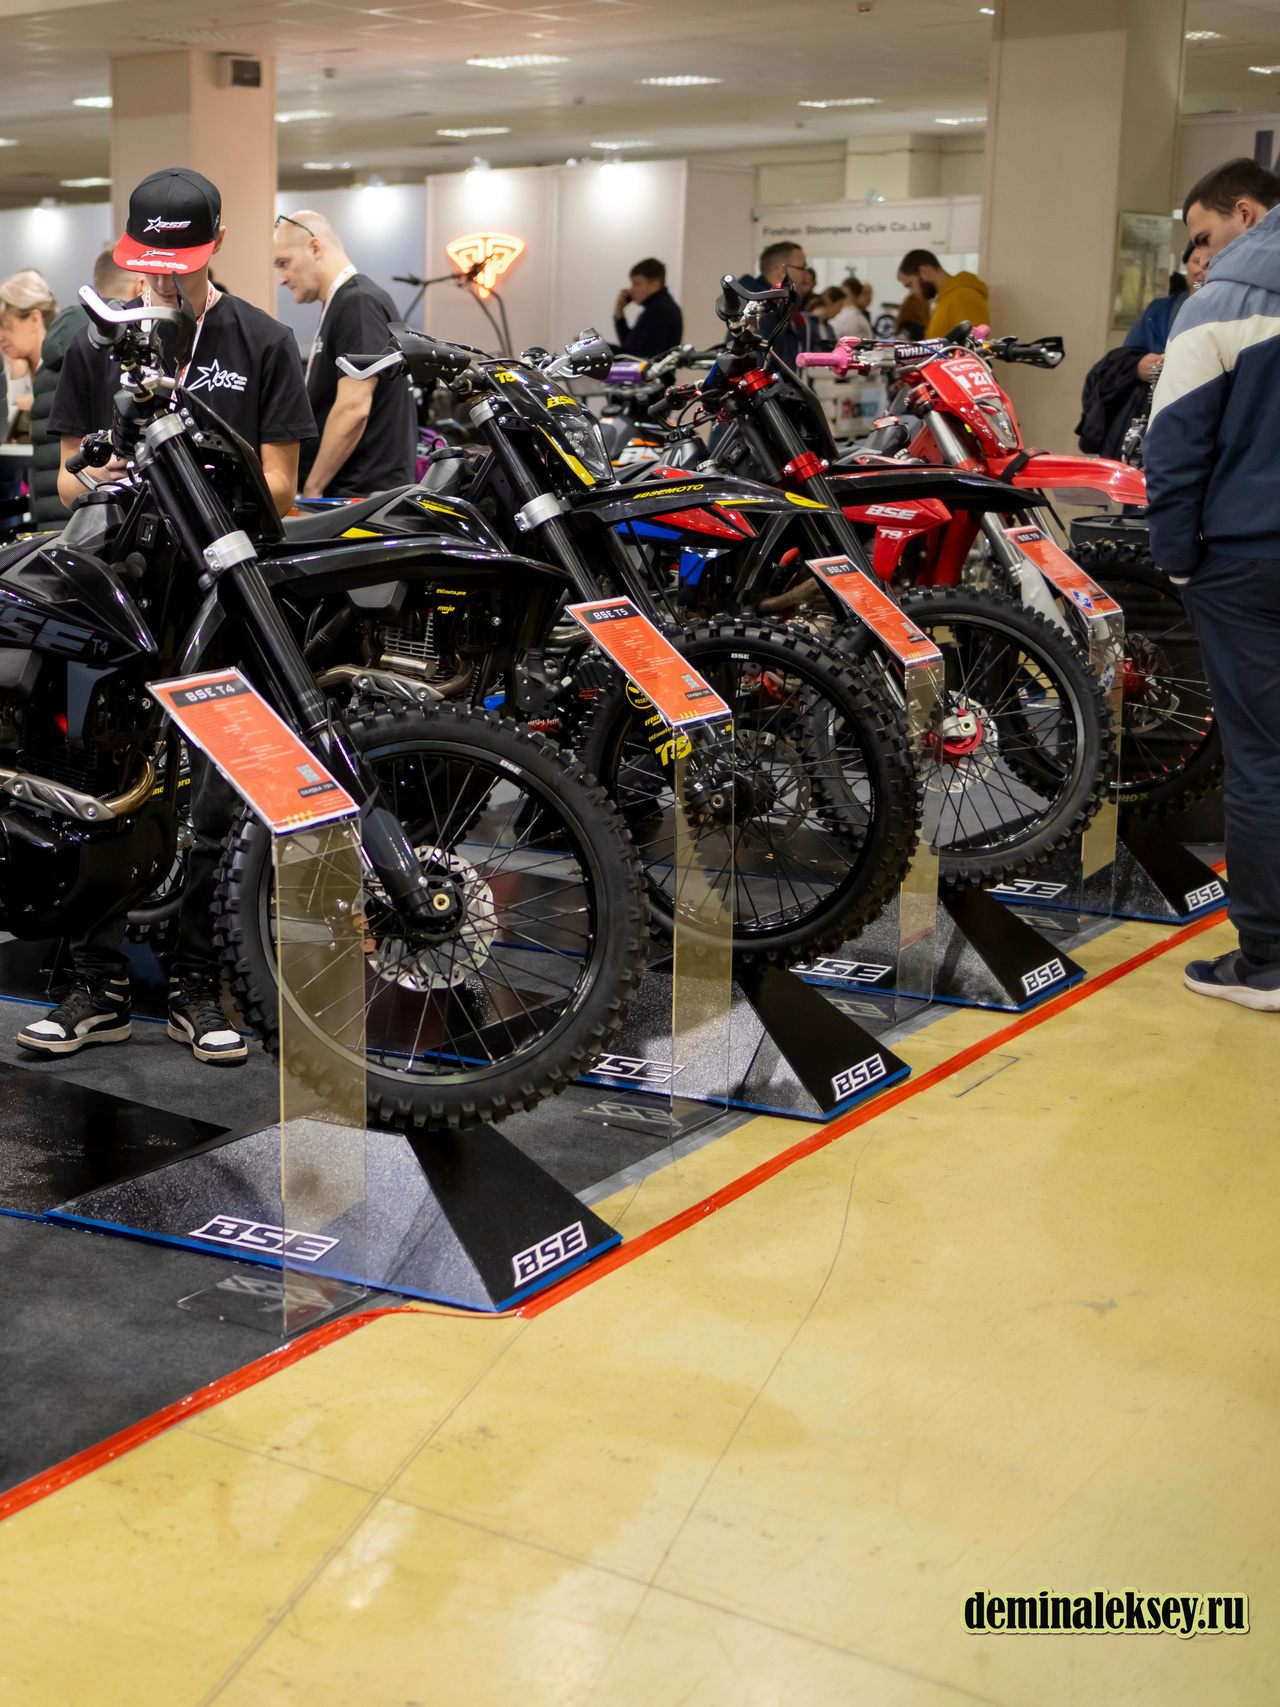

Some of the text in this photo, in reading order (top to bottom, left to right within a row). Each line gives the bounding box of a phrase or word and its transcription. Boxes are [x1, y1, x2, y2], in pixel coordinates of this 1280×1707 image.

[856, 222, 887, 235] Cycle
[213, 369, 248, 392] BSE
[632, 483, 705, 500] #BSEMOTO
[865, 504, 918, 521] BSE
[878, 529, 904, 540] T9
[593, 608, 629, 620] BSE T5
[91, 638, 109, 656] T4
[185, 683, 236, 702] BSE T4
[644, 713, 663, 727] moj
[654, 735, 693, 767] T5
[499, 758, 522, 775] BSE
[988, 879, 1067, 898] SE
[1184, 880, 1224, 911] BSE
[1021, 958, 1066, 996] BSE
[594, 1053, 684, 1082] SE
[831, 1053, 886, 1101] BSE
[193, 1214, 338, 1261] BSE
[512, 1221, 588, 1288] BSE
